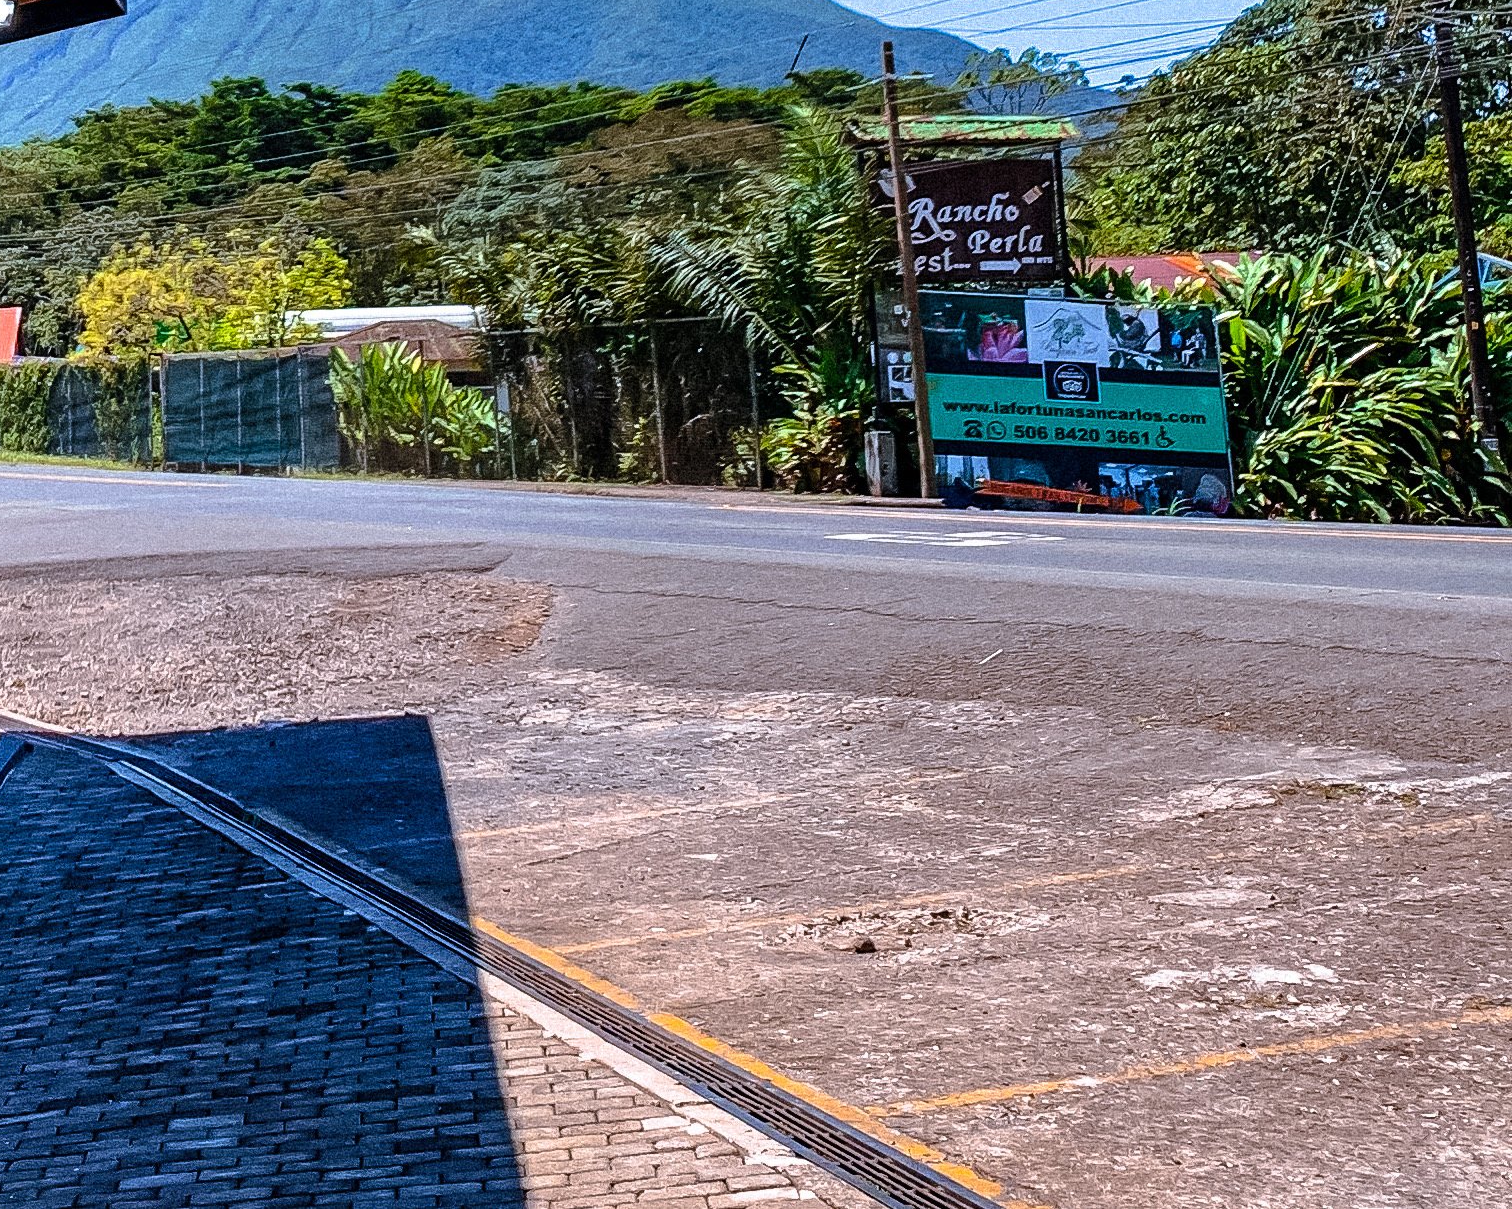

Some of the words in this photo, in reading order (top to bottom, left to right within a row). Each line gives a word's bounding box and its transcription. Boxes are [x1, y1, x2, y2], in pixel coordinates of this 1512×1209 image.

[908, 191, 1020, 242] Rancho
[967, 224, 1044, 255] Perla
[942, 400, 1207, 425] www.lafortunasancarlos.com
[1013, 423, 1049, 440] 506
[1054, 425, 1101, 442] 8420
[1105, 428, 1150, 445] 3661
